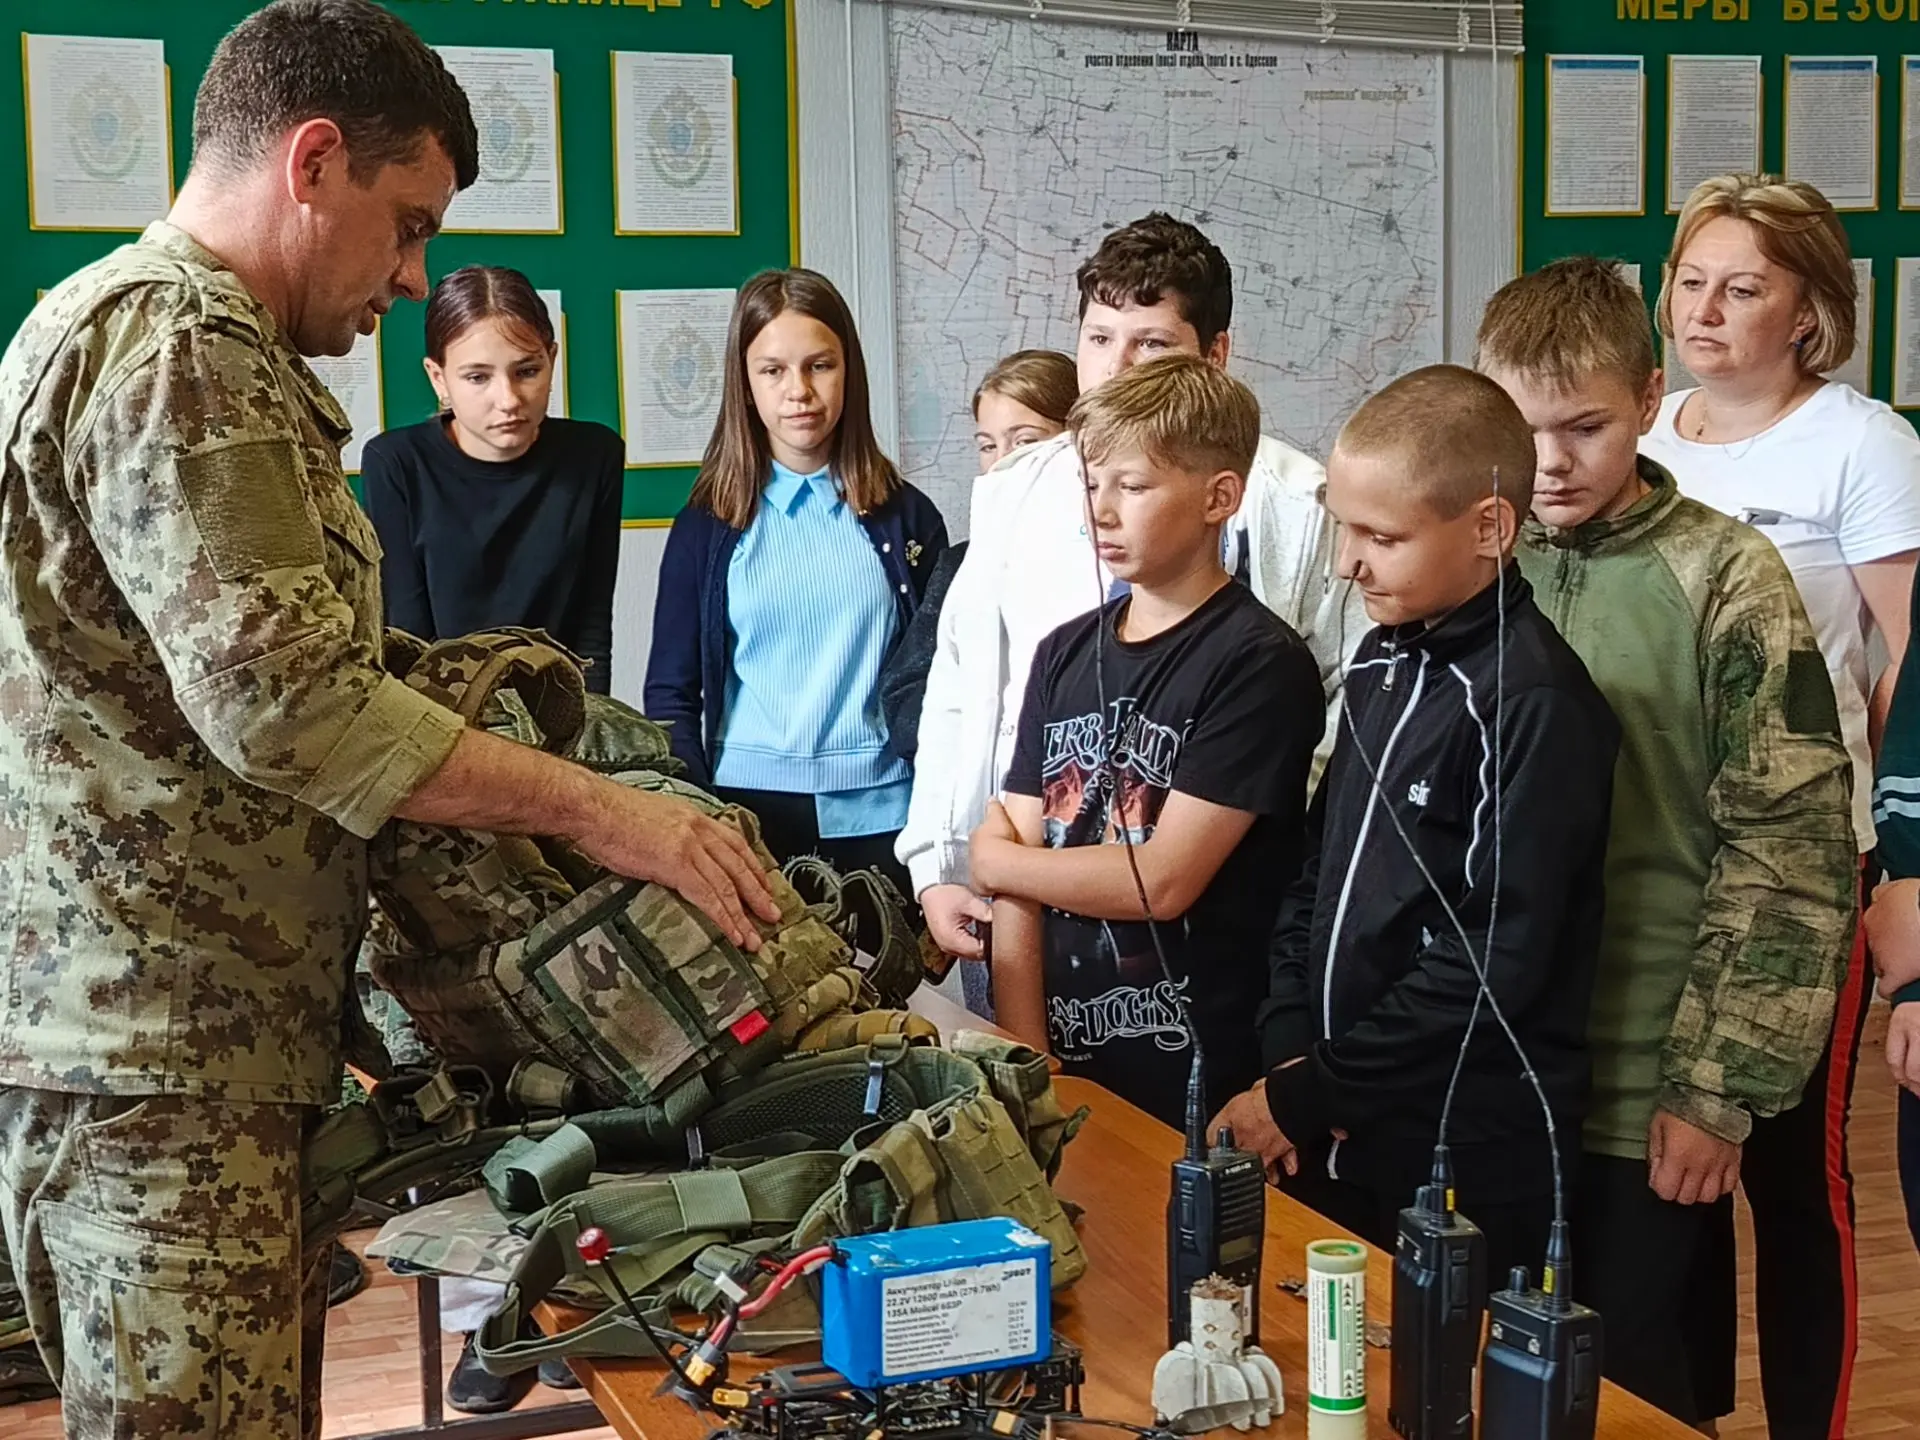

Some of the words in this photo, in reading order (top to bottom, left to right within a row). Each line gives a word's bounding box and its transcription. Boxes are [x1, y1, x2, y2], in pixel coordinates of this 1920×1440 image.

[1616, 0, 1749, 20] МЕРЫ
[1166, 32, 1198, 51] КАРТА
[1080, 976, 1191, 1051] DOGS
